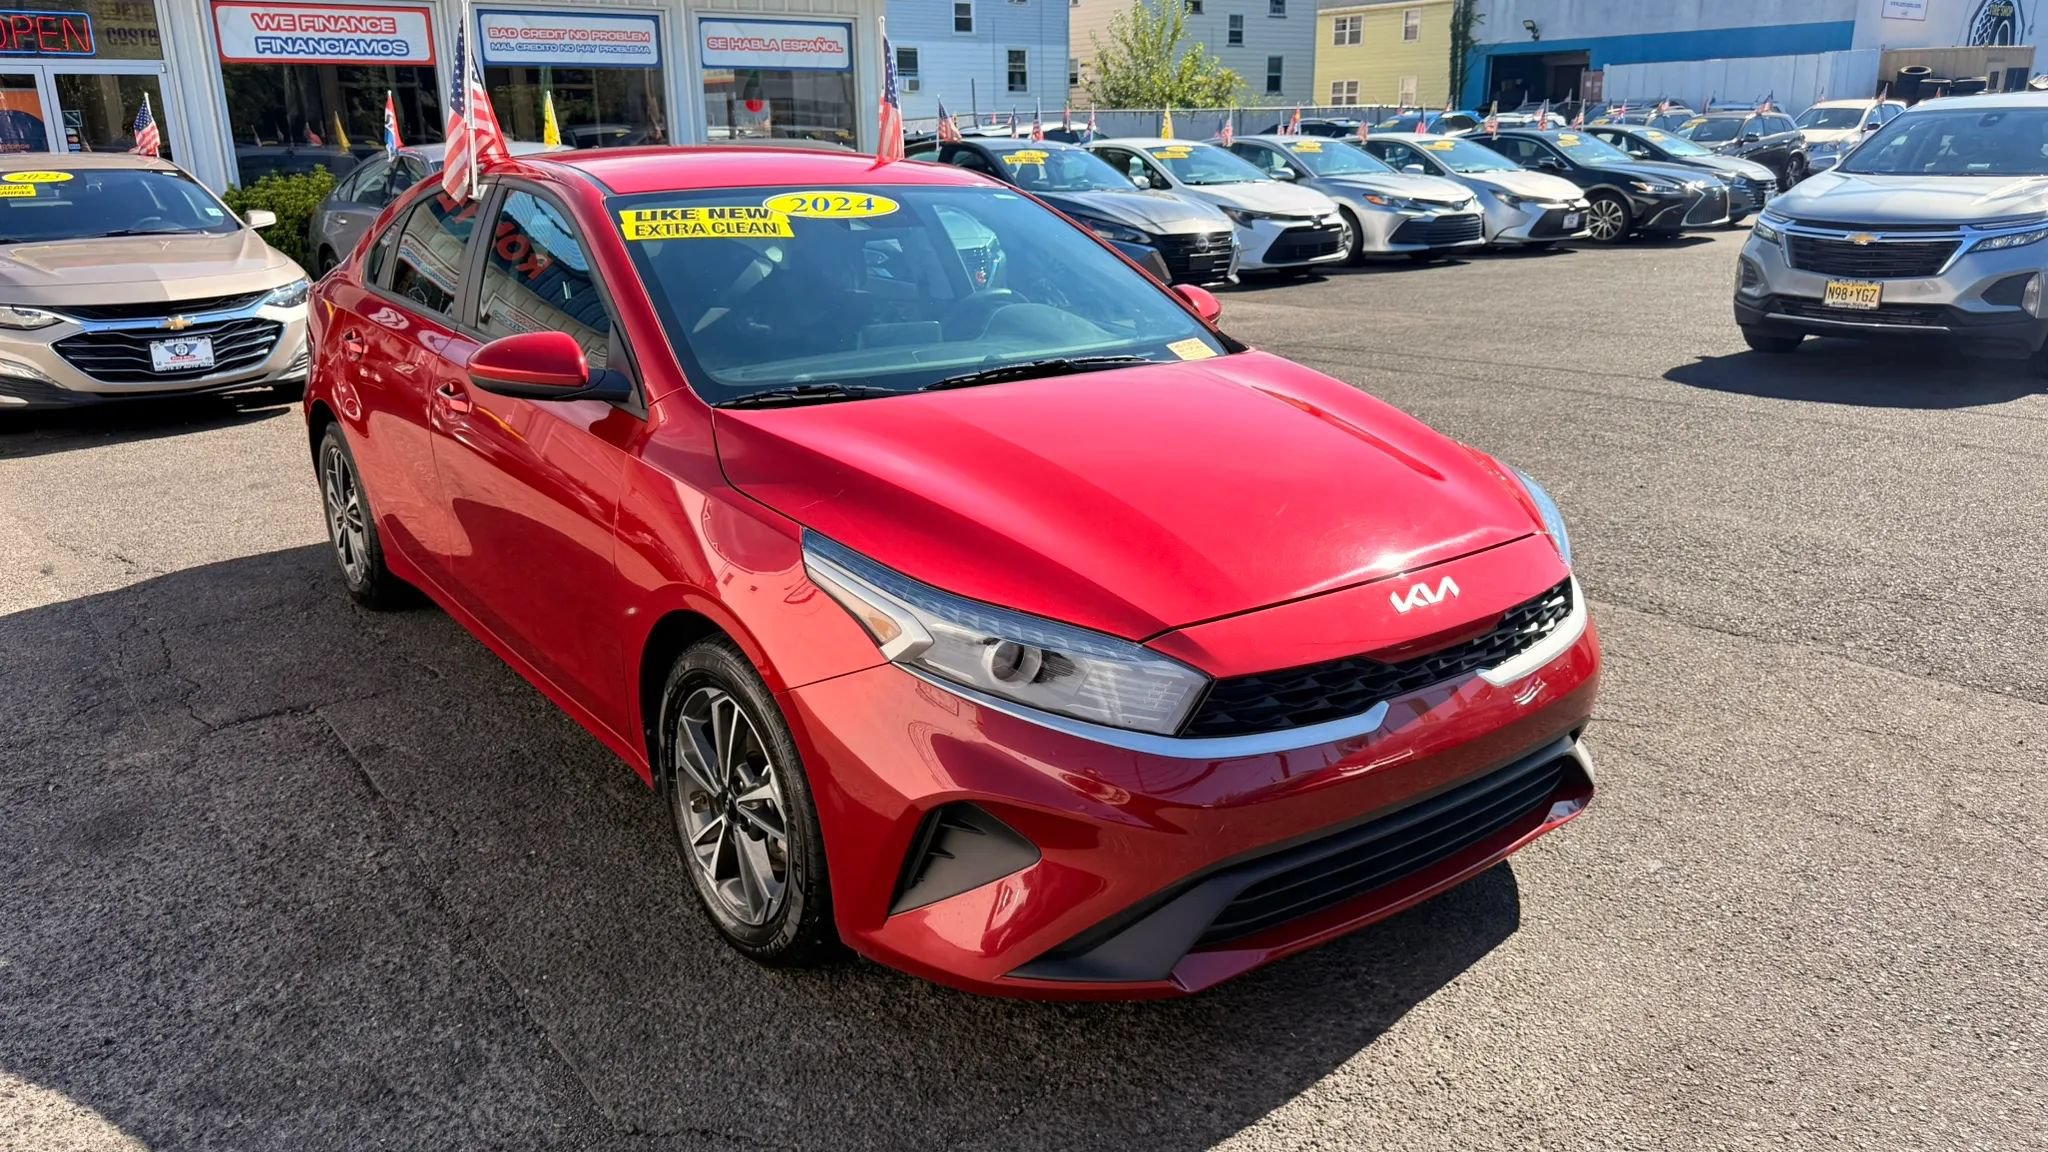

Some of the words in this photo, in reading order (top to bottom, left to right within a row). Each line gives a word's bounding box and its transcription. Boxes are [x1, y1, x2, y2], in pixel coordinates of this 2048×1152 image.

[251, 13, 295, 31] WE
[298, 15, 396, 34] FINANCE
[0, 15, 90, 51] PEN
[488, 27, 517, 38] BAD
[520, 28, 566, 40] CREDIT
[569, 30, 588, 40] NO
[591, 30, 650, 42] PROBLEM
[255, 37, 409, 56] FINANCIAMOS
[490, 42, 515, 51] MAL
[515, 43, 558, 52] CREDITO
[559, 44, 574, 52] NO
[576, 44, 597, 53] HAY
[598, 45, 651, 54] PROBLEMA
[707, 36, 727, 50] SE
[729, 37, 779, 51] HABLA
[781, 37, 843, 53] ESPAÑOL
[791, 196, 875, 213] 2024
[635, 208, 696, 222] LIKE
[708, 207, 770, 220] NEW
[635, 222, 706, 236] EXTRA
[711, 221, 779, 235] CLEAN
[1389, 576, 1460, 614] KIA
